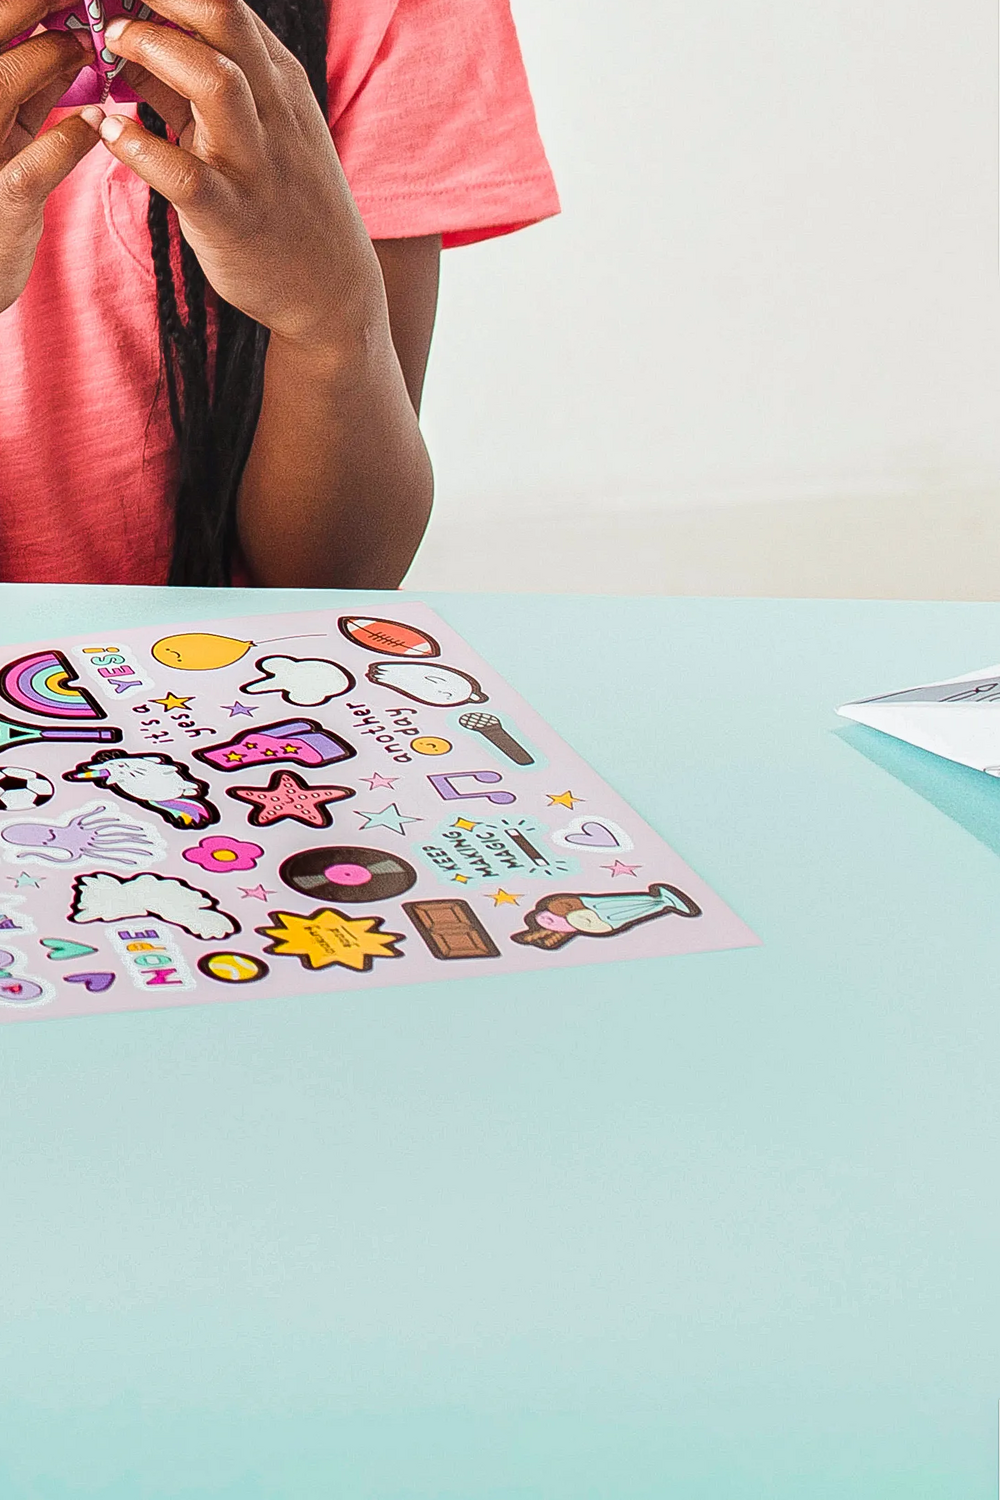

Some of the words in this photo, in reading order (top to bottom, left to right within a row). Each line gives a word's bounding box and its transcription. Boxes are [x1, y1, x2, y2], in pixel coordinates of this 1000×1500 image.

[82, 647, 143, 694] YES!
[132, 704, 151, 714] a
[385, 708, 420, 736] day
[140, 719, 174, 744] it's
[170, 713, 217, 738] yes
[346, 703, 413, 763] another
[422, 845, 462, 873] KEEP
[441, 830, 499, 878] MAKING
[475, 832, 525, 869] MAGIC
[117, 929, 183, 986] NOPE
